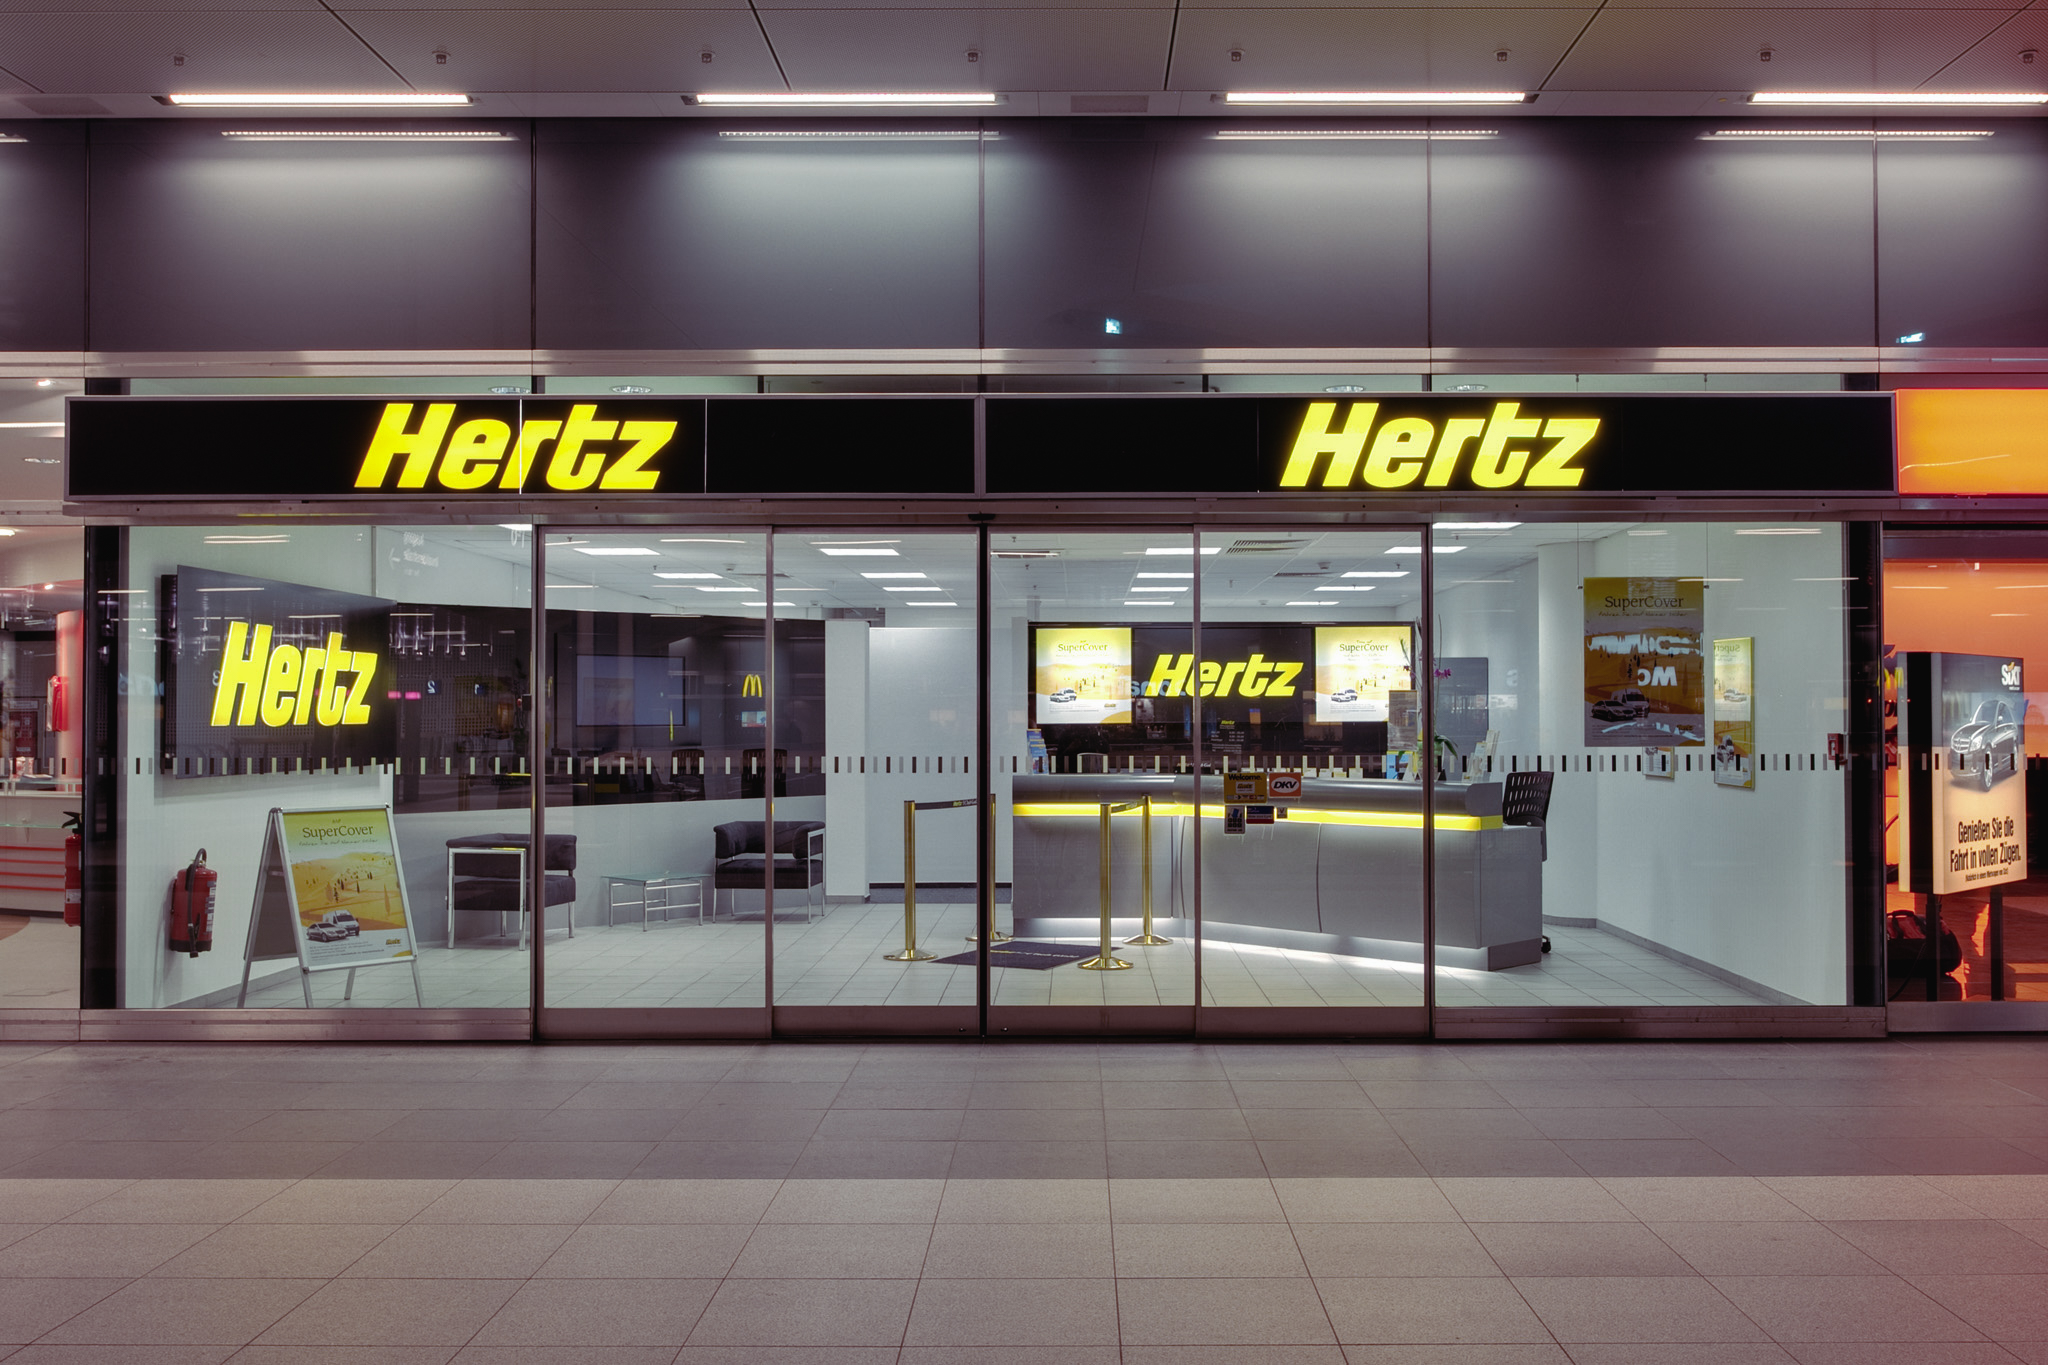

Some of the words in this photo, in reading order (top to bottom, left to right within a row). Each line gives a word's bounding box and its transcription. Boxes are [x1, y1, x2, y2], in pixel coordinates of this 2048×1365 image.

[354, 402, 678, 490] Hertz
[1279, 402, 1601, 488] Hertz
[1604, 595, 1685, 612] SuperCover
[1057, 642, 1108, 653] SuperCover
[1339, 642, 1389, 653] SuperCover
[210, 620, 378, 728] Hertz
[1144, 653, 1304, 697] Hertz
[1228, 773, 1262, 781] Welcome.
[1273, 781, 1297, 789] DKV
[302, 825, 374, 840] SuperCover
[1958, 819, 1990, 844] Genießen
[1992, 816, 2002, 839] Sie
[2004, 815, 2014, 838] die
[1950, 848, 1969, 873] Fahrt
[1970, 847, 1977, 870] in
[1978, 844, 1998, 868] vollen
[2000, 841, 2021, 866] Zügen.
